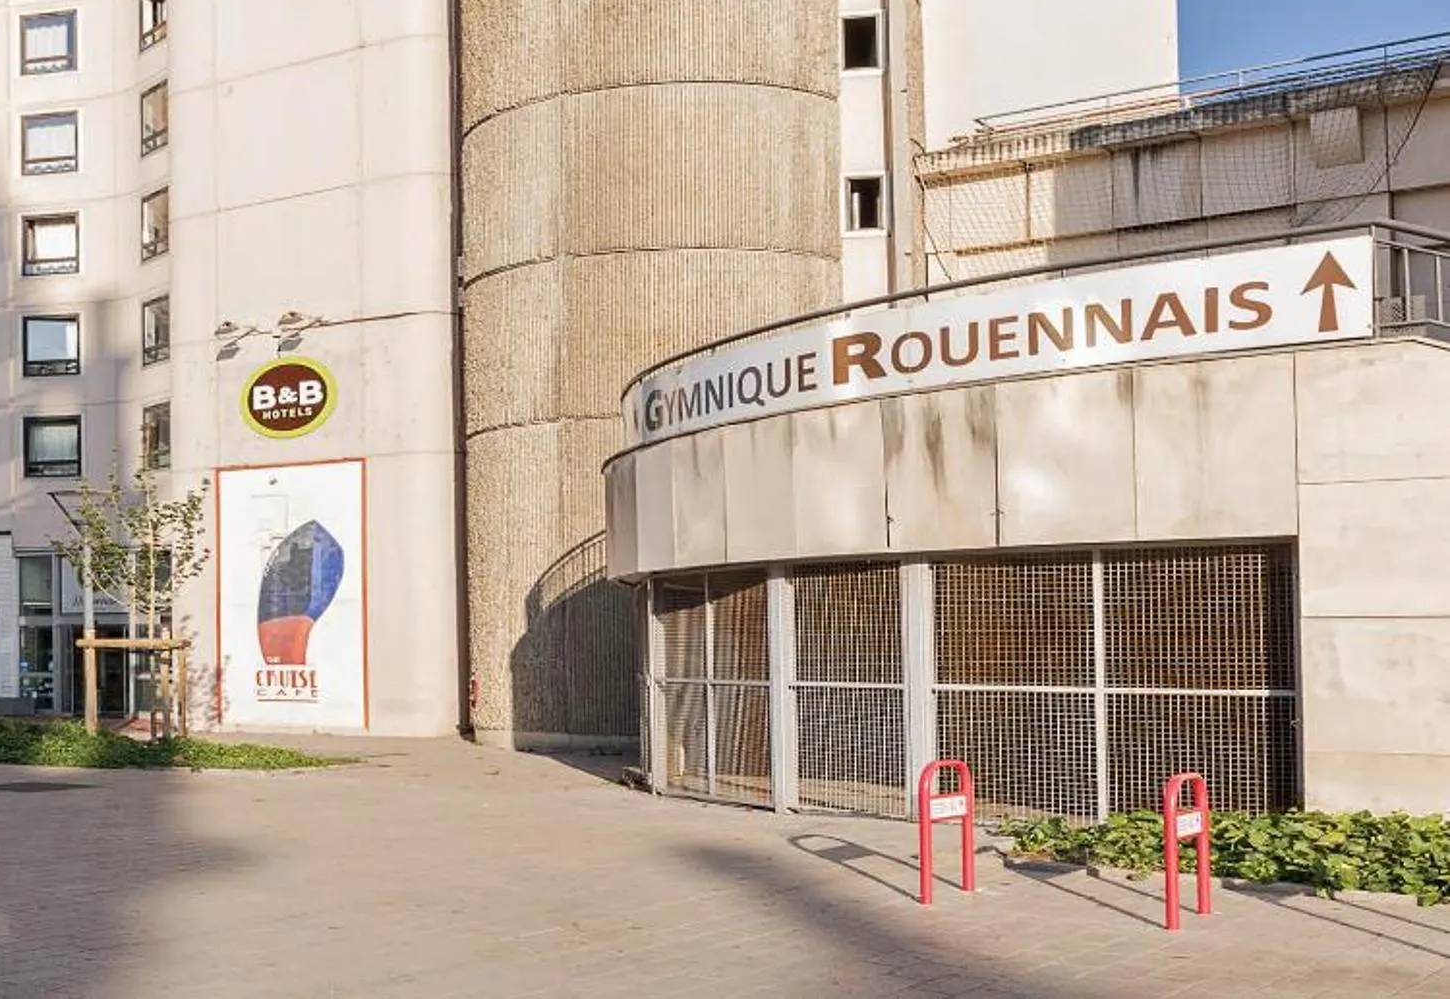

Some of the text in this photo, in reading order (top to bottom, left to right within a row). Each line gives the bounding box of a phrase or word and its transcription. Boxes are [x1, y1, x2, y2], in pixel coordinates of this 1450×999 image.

[645, 281, 1273, 431] GYMNIQUE ROUENNAIS
[252, 380, 324, 410] B&B
[262, 407, 313, 420] HOTELS
[256, 669, 318, 688] CRUISE
